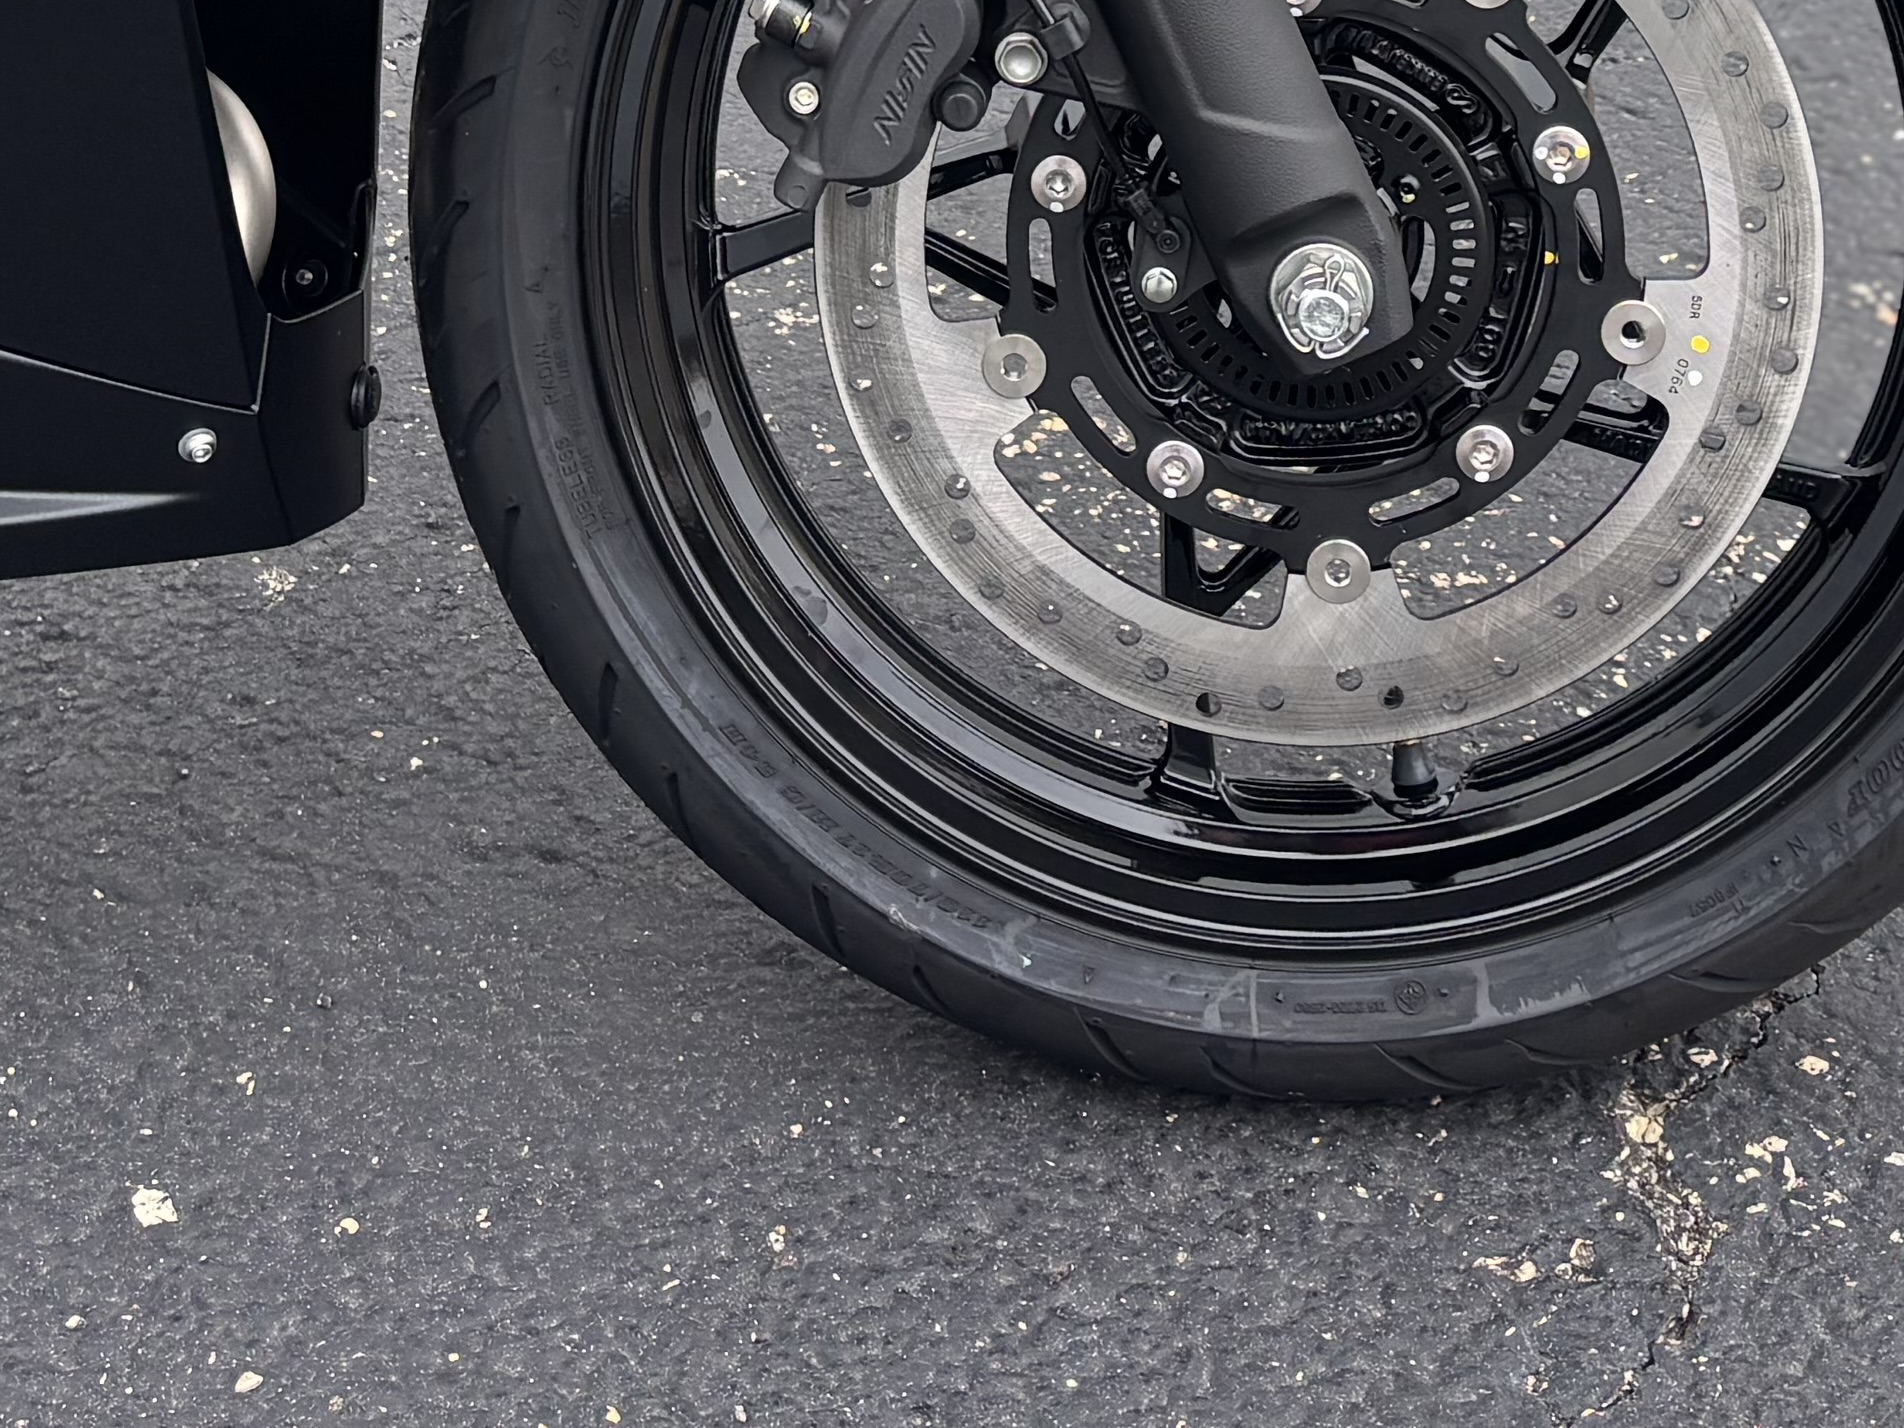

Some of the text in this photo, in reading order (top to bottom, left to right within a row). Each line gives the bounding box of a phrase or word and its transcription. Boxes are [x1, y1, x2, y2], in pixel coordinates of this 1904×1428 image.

[1668, 358, 1689, 394] 0764
[531, 335, 604, 539] TUBELESS RADIAL
